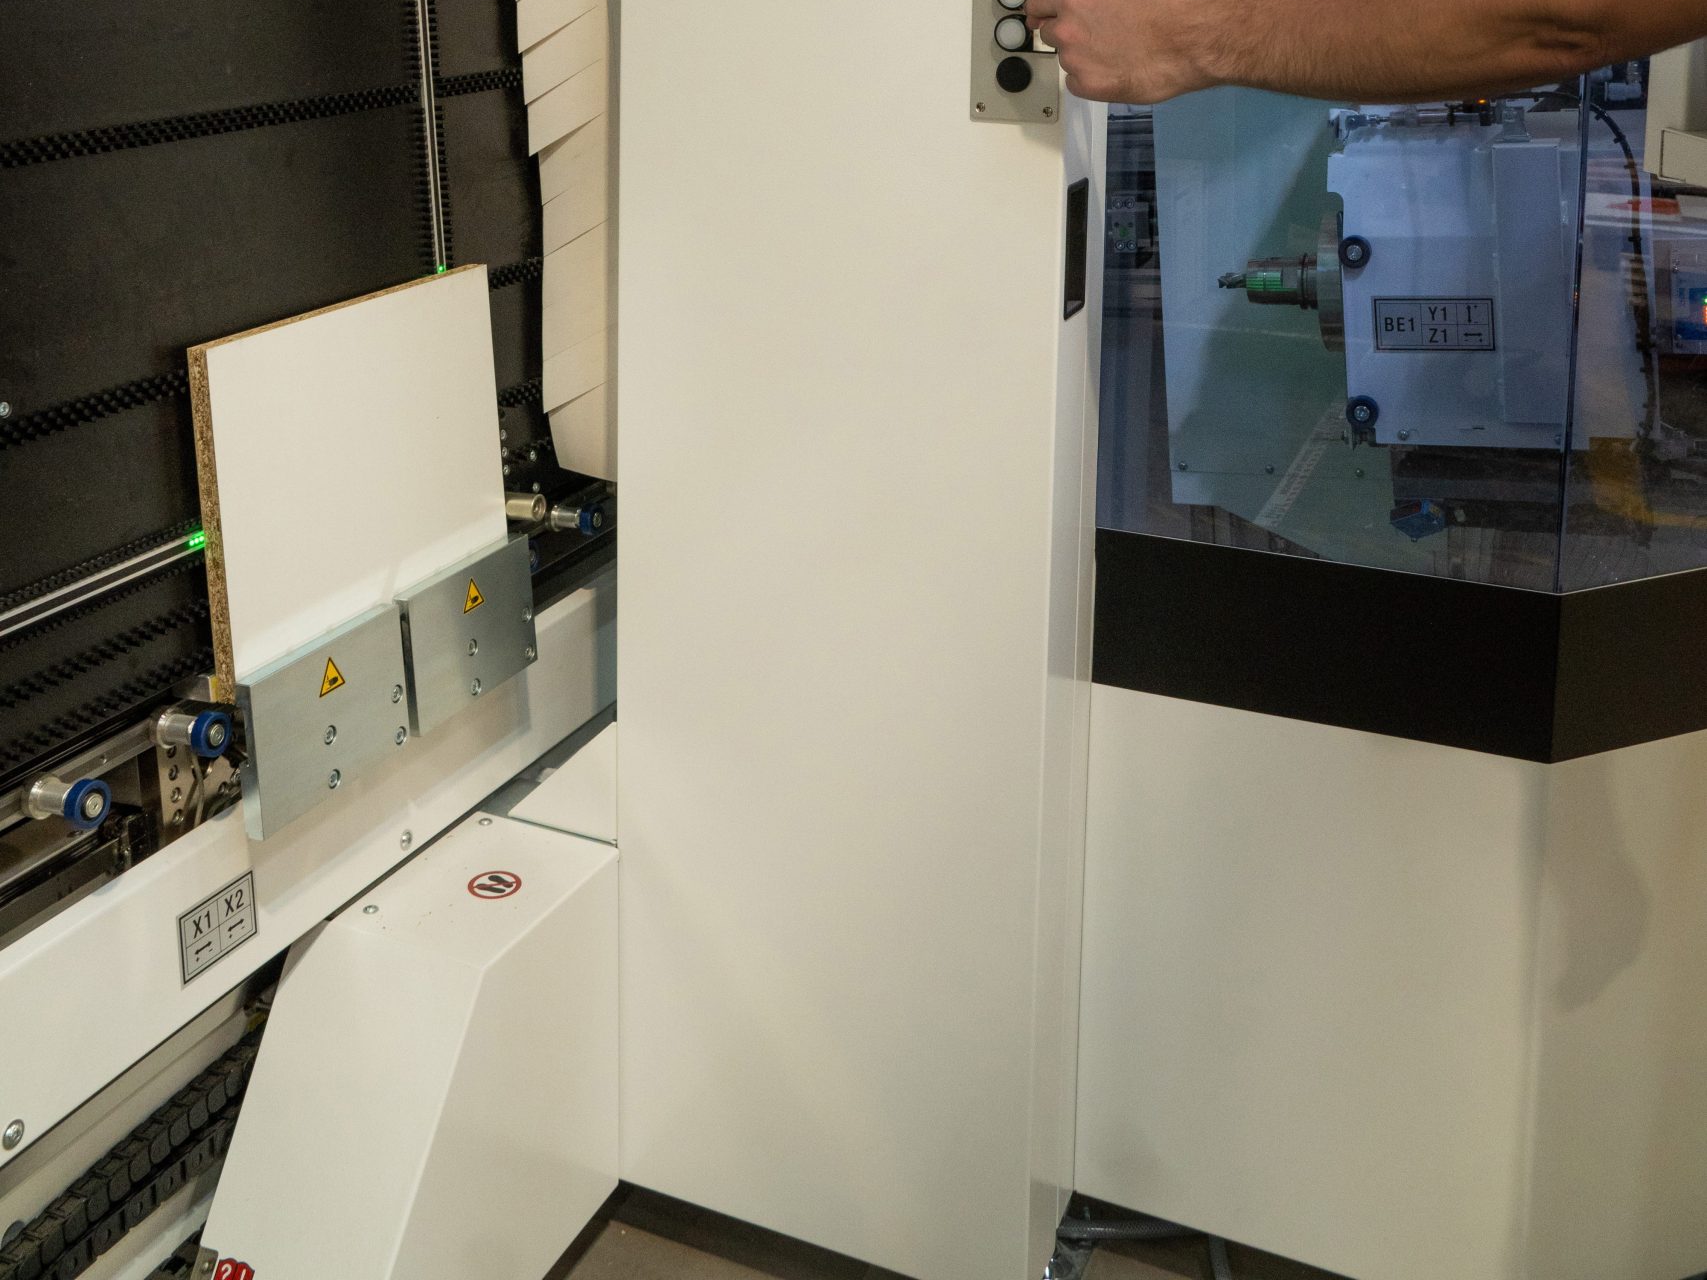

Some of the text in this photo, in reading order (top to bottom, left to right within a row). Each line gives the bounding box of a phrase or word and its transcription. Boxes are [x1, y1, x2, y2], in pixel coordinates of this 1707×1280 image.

[1428, 306, 1448, 320] Y1
[1384, 317, 1415, 332] BE1
[1429, 328, 1448, 343] Z1
[192, 889, 244, 939] X1 X2
